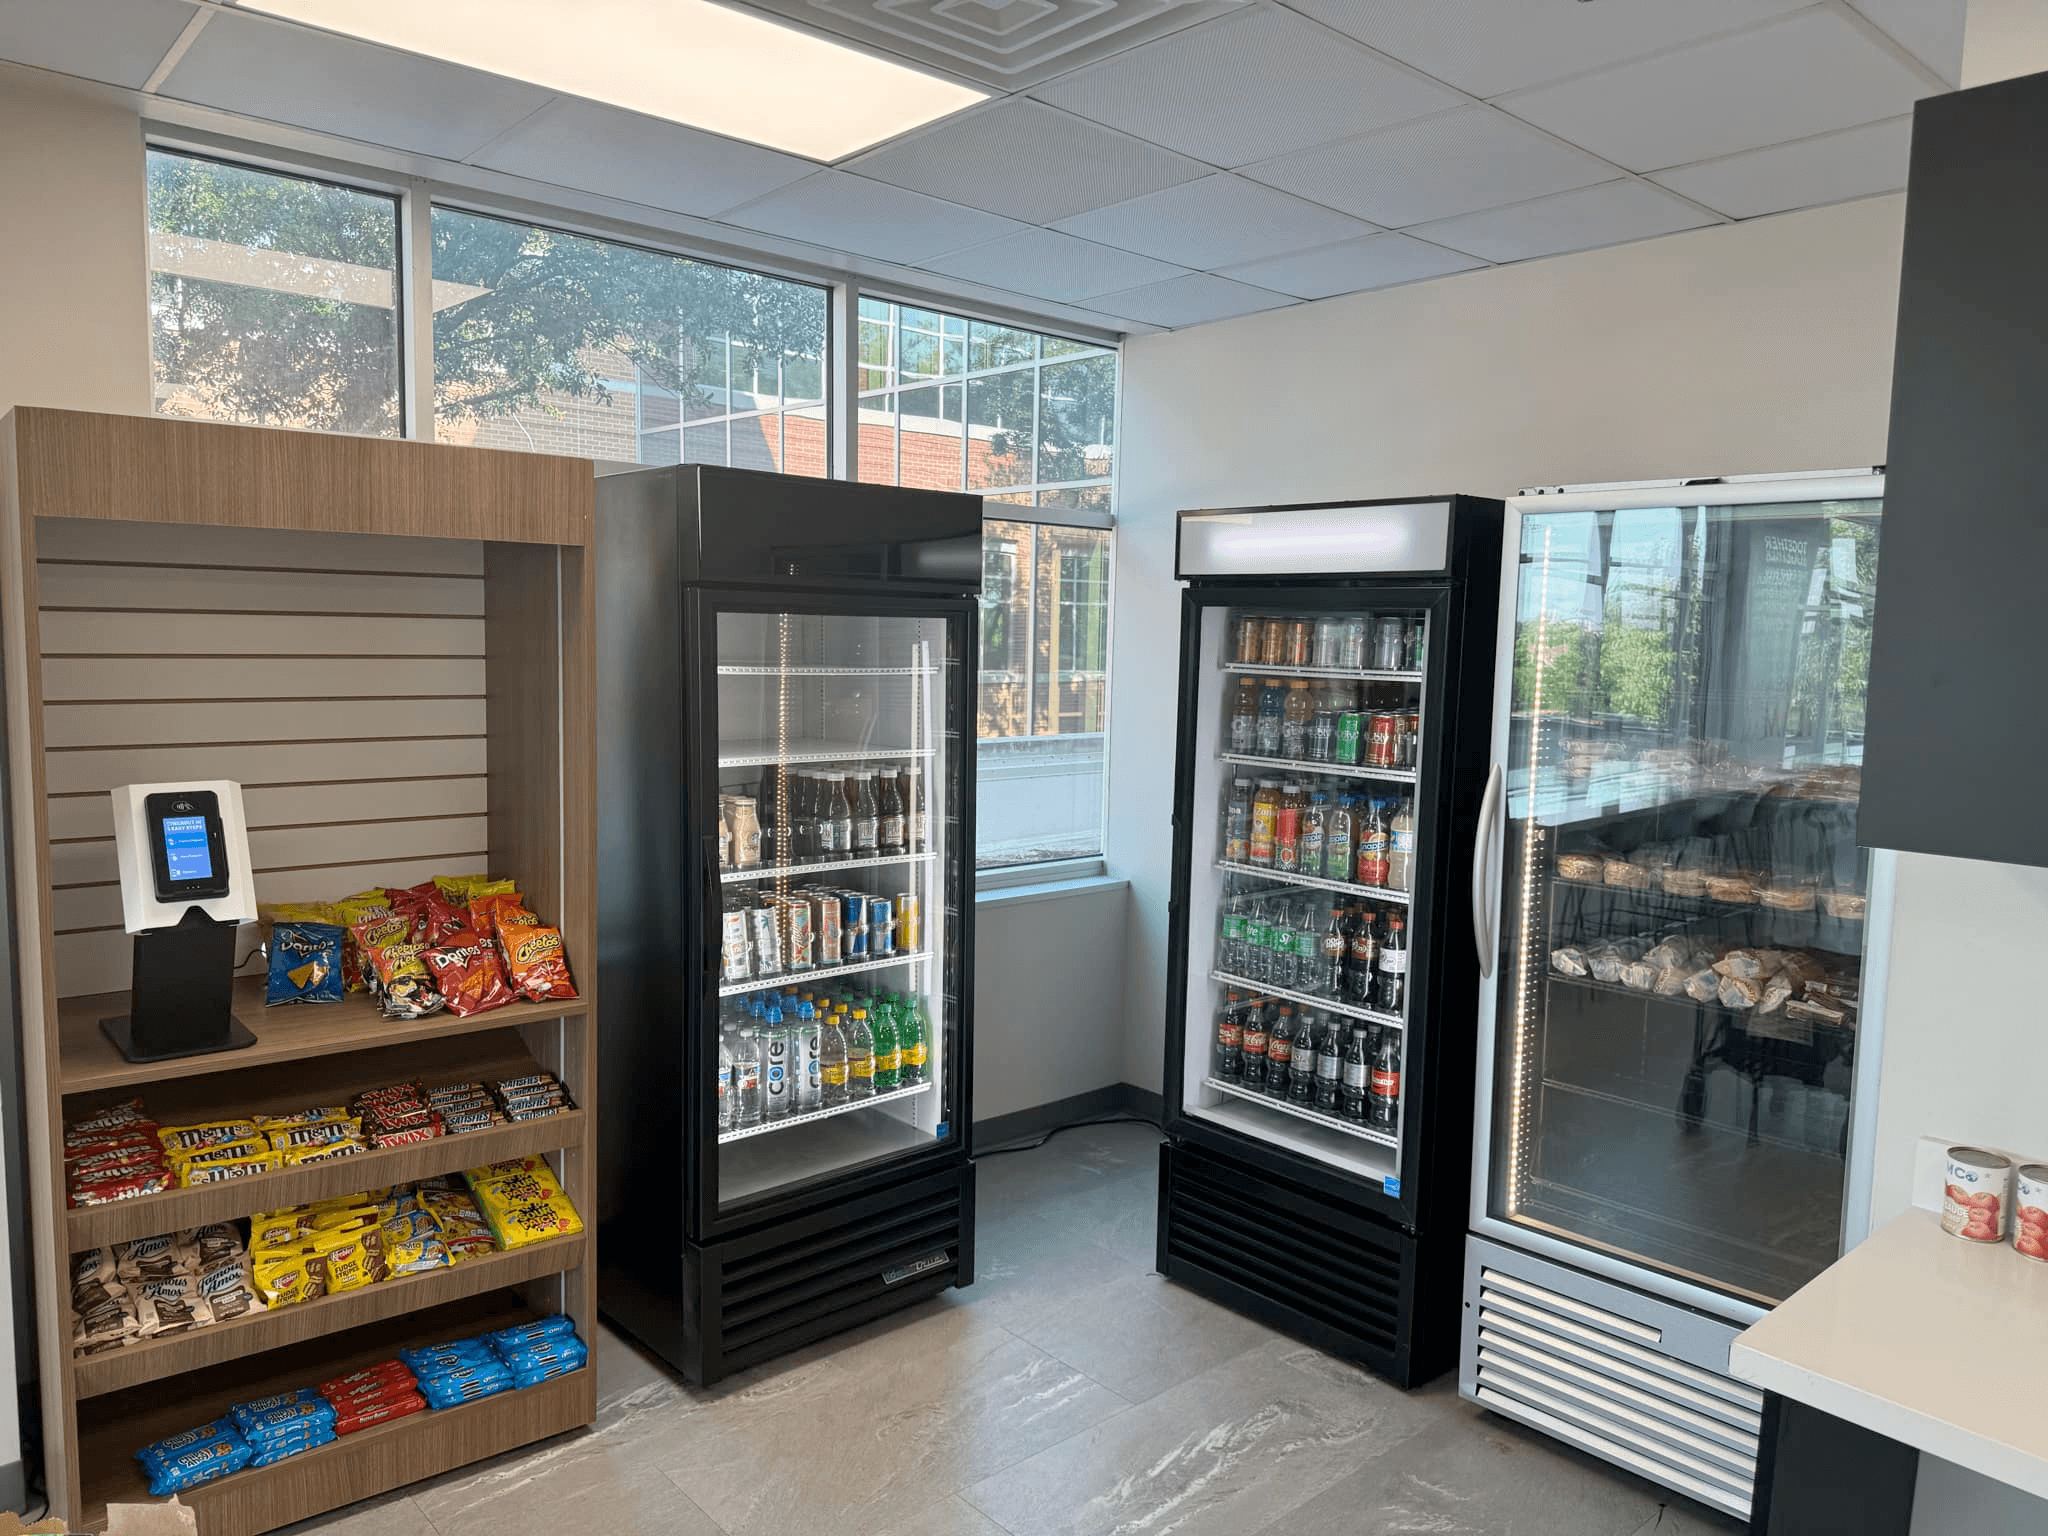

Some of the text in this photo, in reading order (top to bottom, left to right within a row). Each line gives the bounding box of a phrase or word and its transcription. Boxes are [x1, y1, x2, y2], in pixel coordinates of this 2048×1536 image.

[517, 935, 560, 962] Cheetos
[768, 1041, 785, 1095] core
[377, 1130, 430, 1148] TWIX
[207, 1272, 243, 1295] Amos
